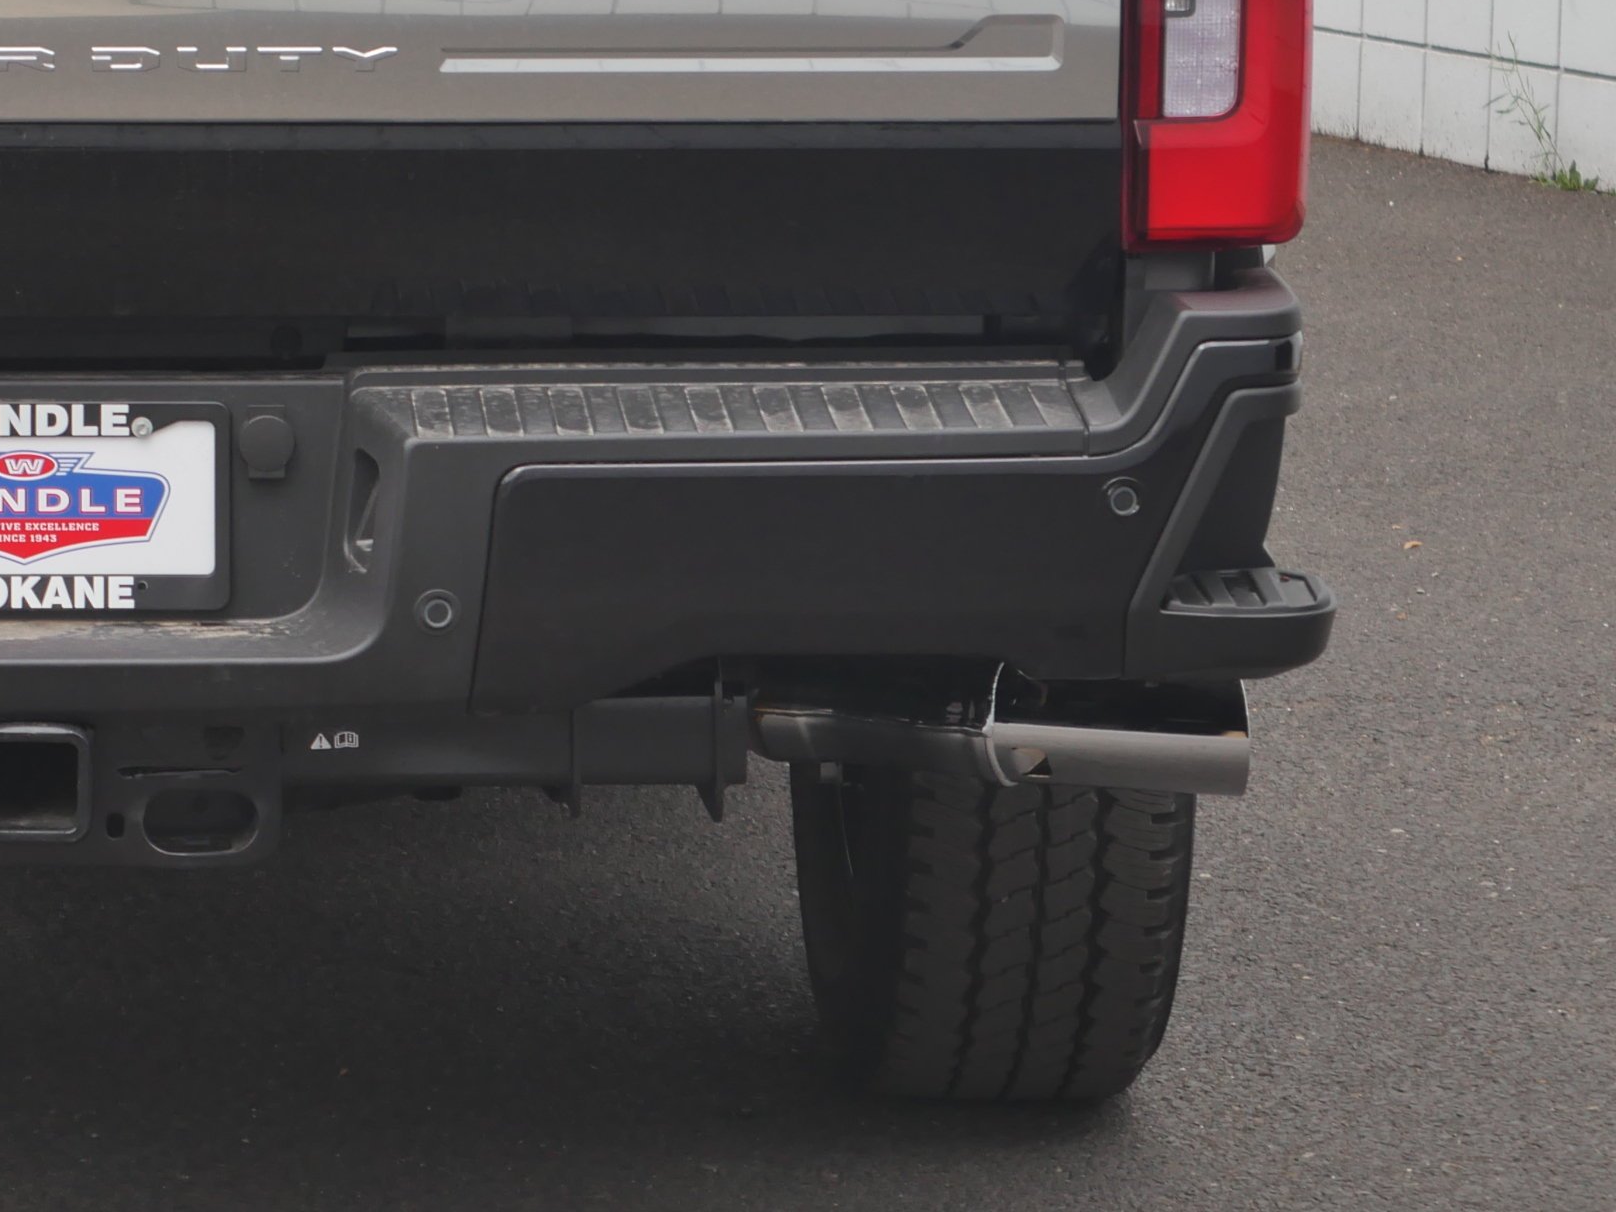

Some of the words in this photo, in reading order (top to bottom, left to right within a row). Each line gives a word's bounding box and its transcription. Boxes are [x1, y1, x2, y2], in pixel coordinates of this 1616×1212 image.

[90, 46, 398, 73] DUTY
[24, 522, 100, 532] EXCELLENCE
[29, 534, 57, 543] 1943
